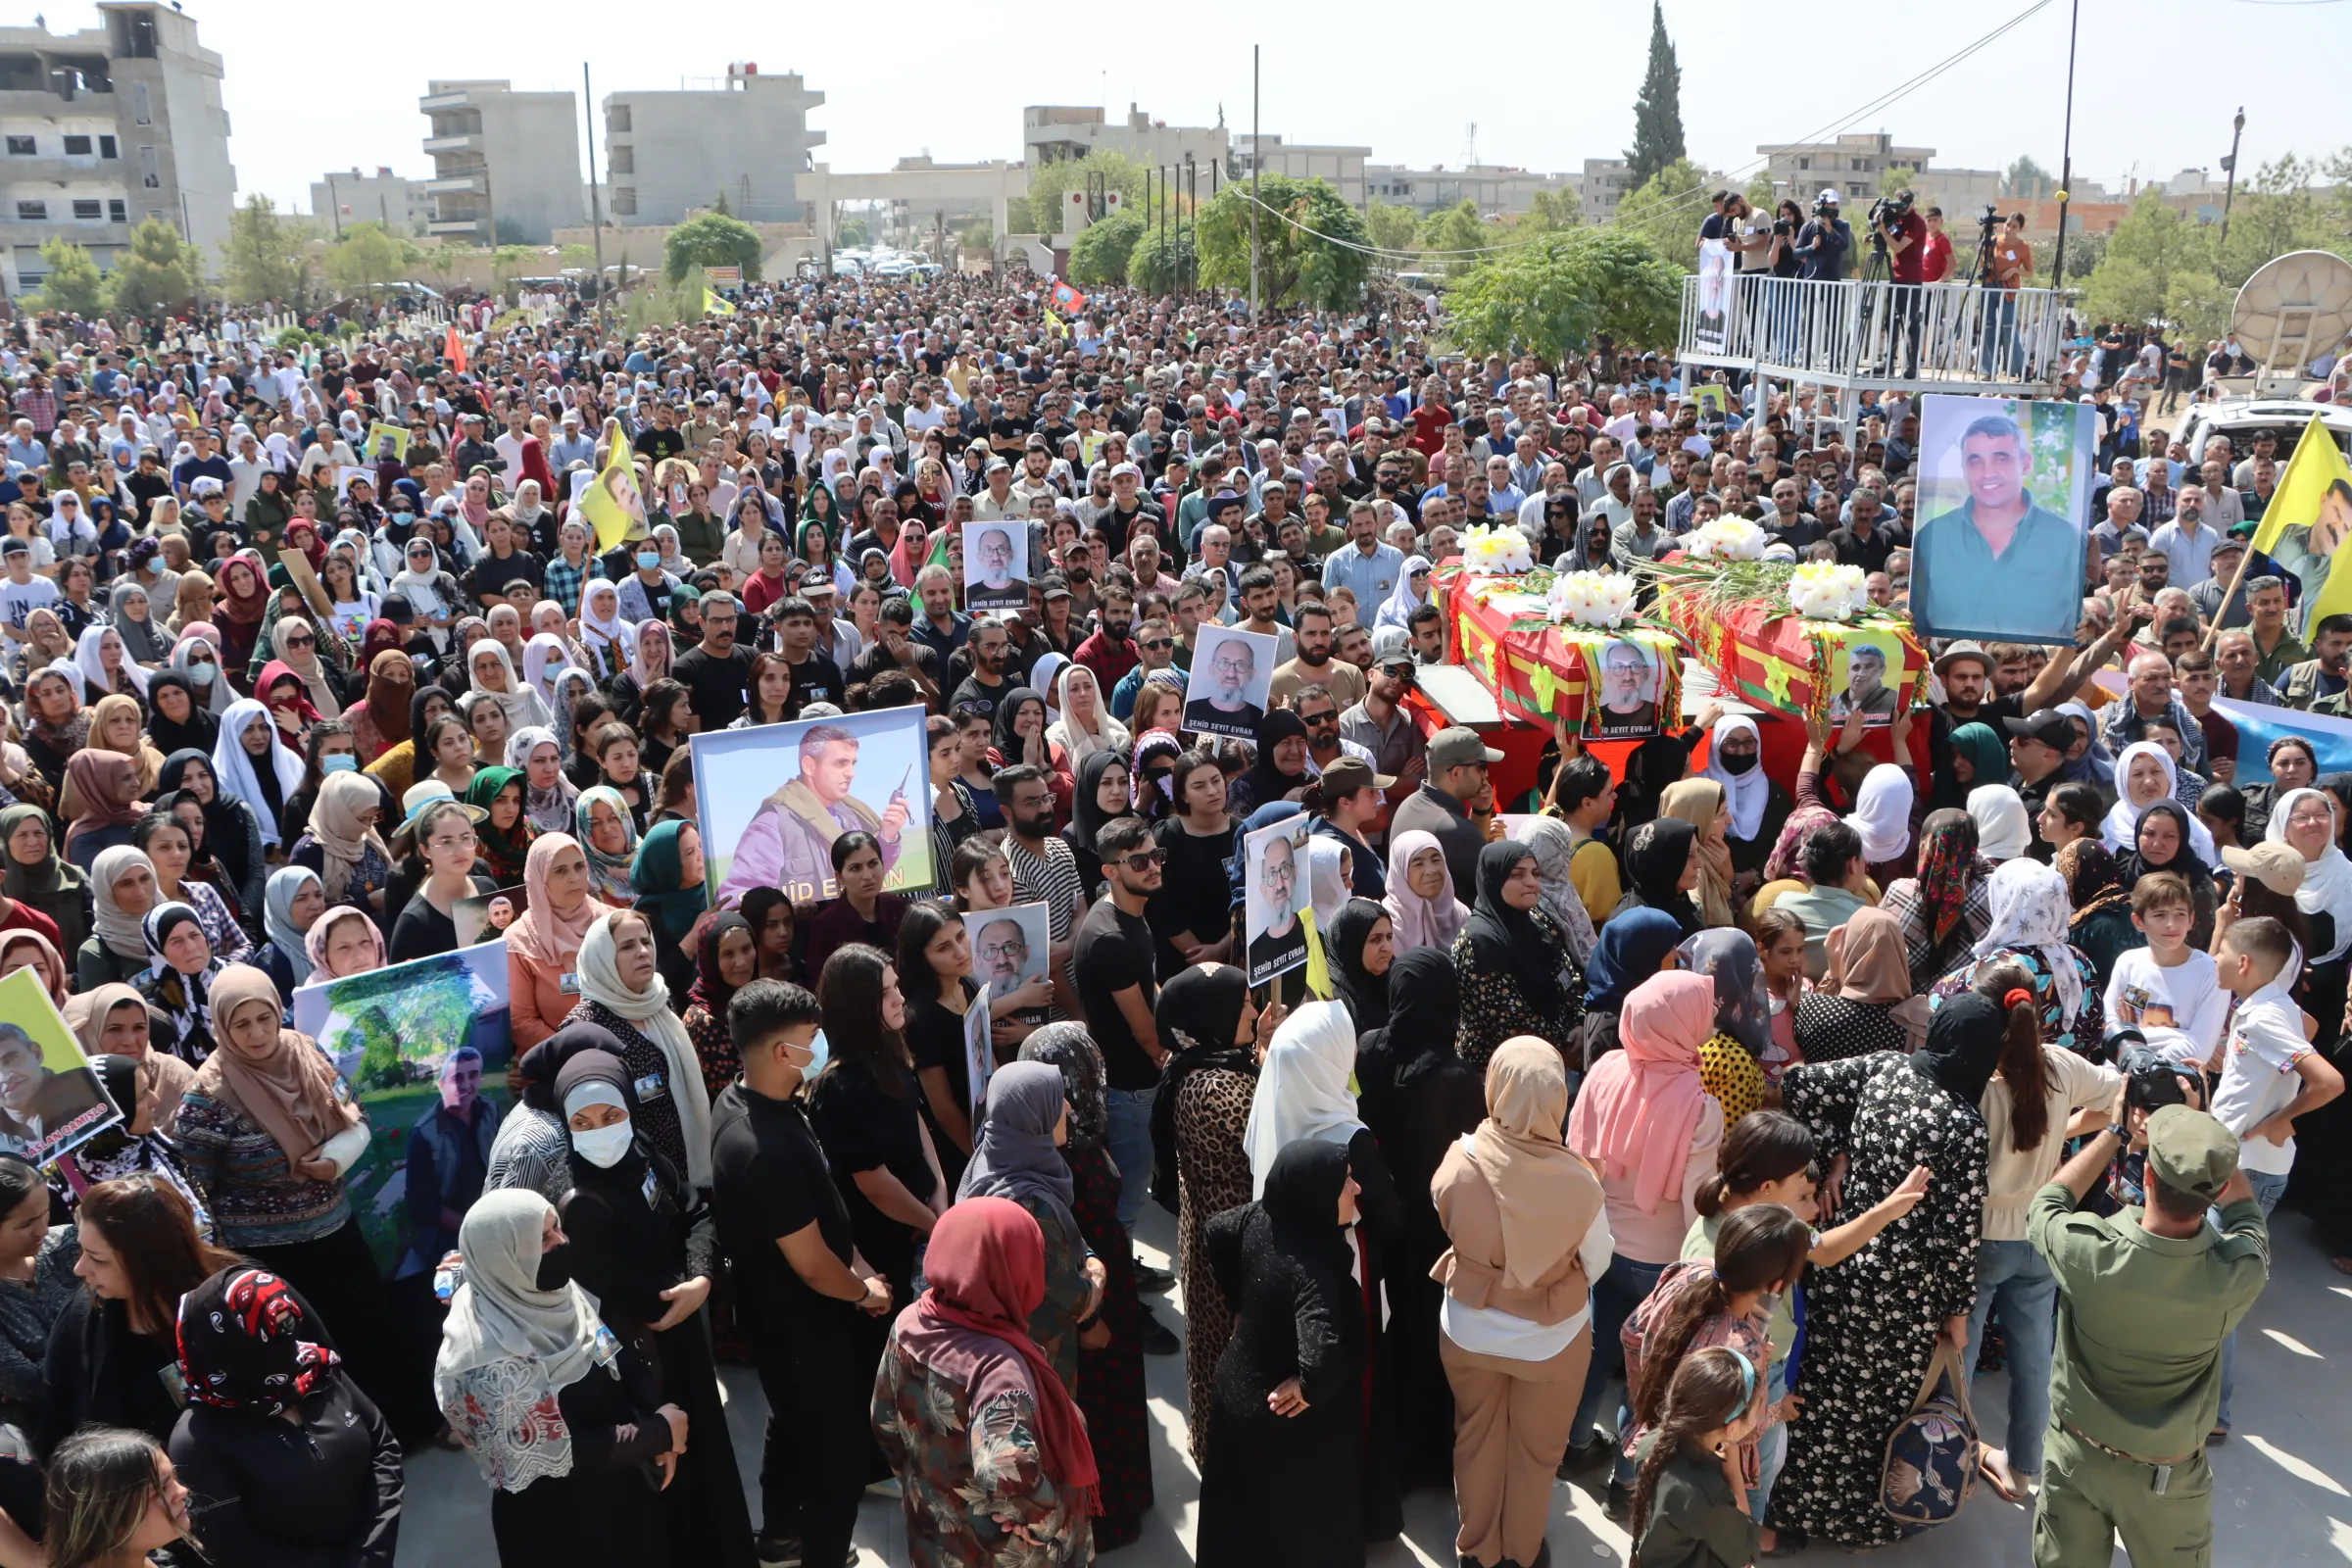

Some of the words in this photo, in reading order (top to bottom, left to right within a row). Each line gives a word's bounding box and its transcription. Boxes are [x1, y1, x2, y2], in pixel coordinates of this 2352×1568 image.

[1231, 725, 1253, 736] EVRAN
[1289, 944, 1305, 960] EVRAN
[28, 1129, 63, 1158] ASLAN
[60, 1102, 109, 1136] QAMIŞLO
